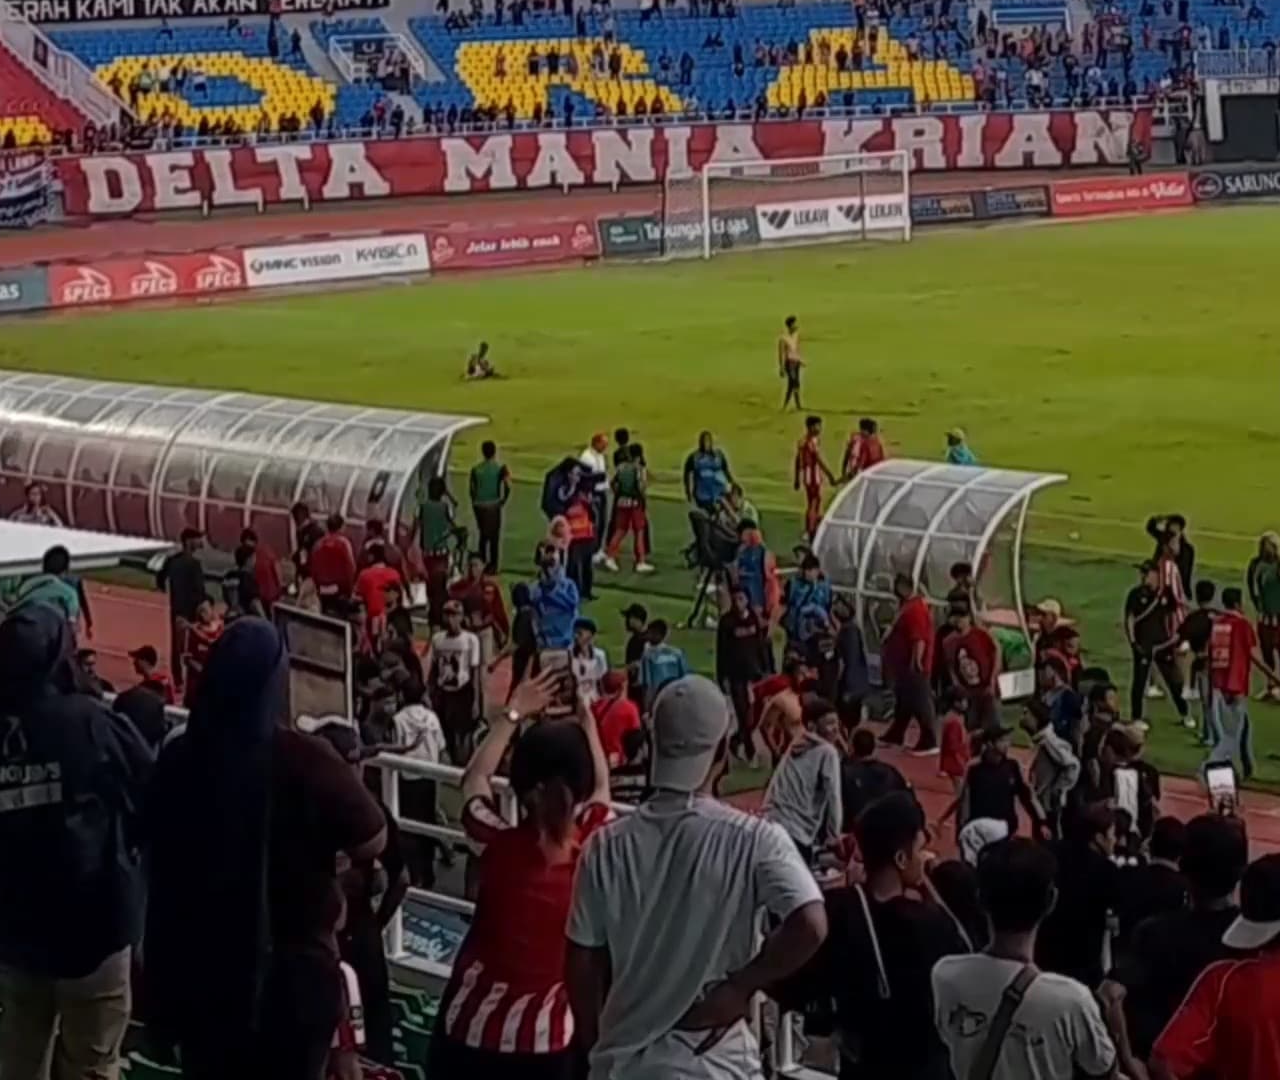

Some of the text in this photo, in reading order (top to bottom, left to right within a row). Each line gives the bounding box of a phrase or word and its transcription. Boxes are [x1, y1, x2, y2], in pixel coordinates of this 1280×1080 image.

[80, 111, 1133, 214] DELTA MANIA KRIAN
[131, 277, 177, 296] SPECS
[196, 270, 242, 290] SPECS
[63, 283, 112, 302] SPECS
